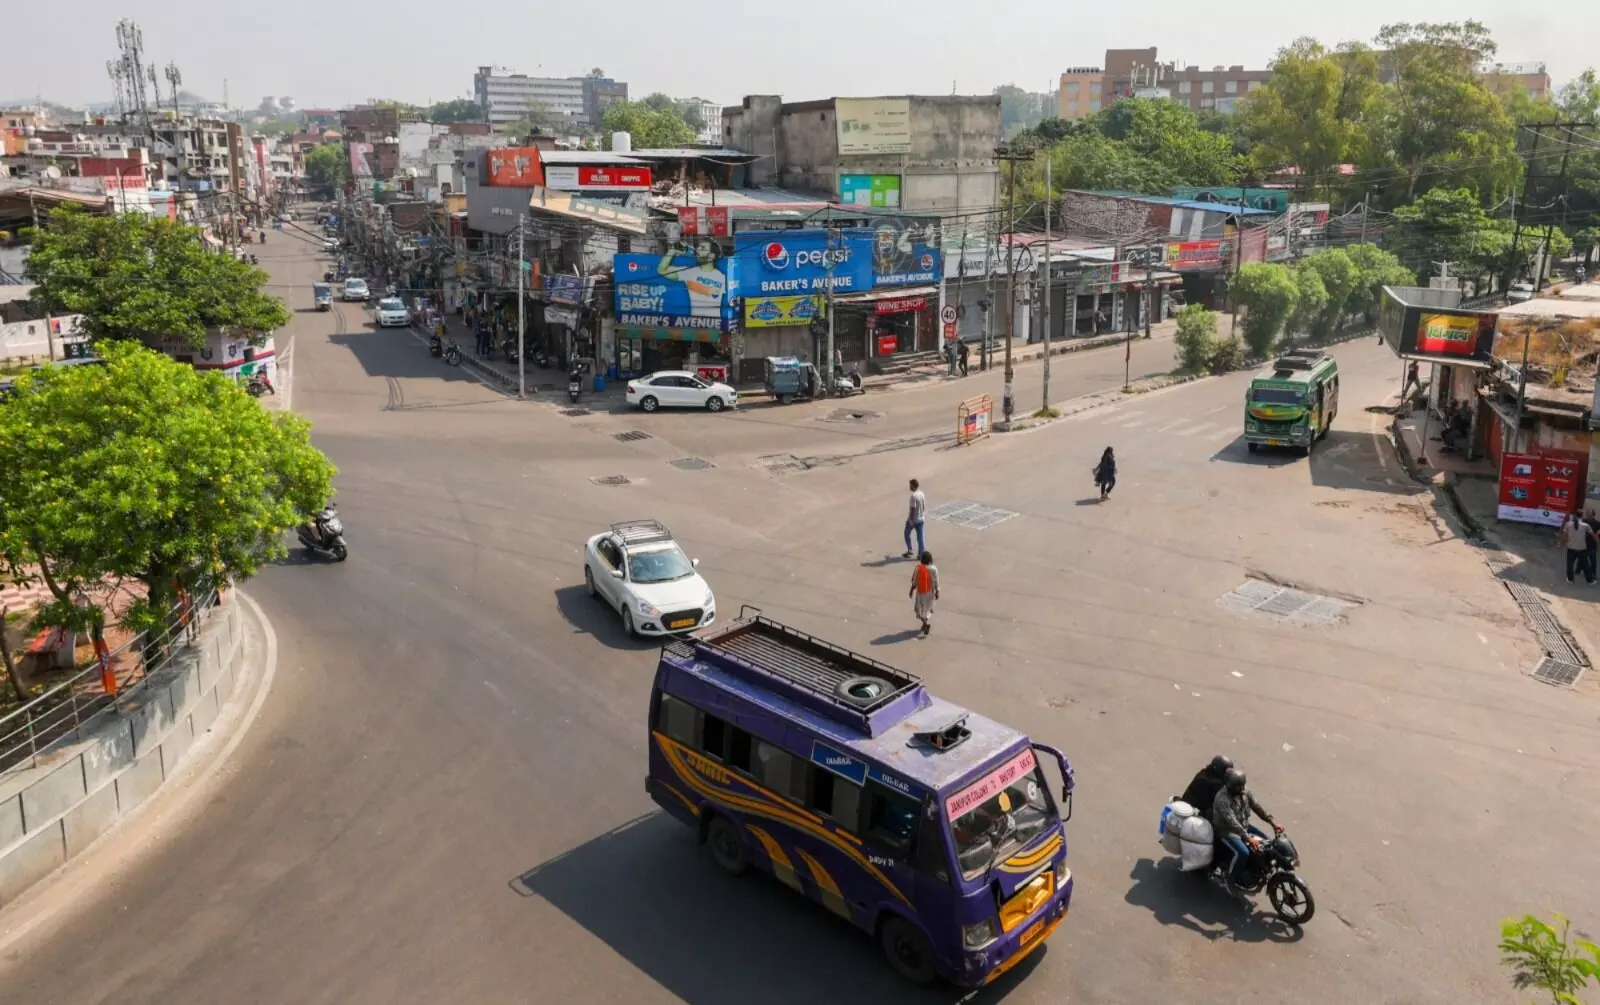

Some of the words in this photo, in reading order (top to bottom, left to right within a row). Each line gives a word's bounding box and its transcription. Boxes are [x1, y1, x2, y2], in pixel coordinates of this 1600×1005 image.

[796, 247, 852, 269] pepsi
[618, 283, 649, 297] RISE
[650, 285, 667, 297] UP
[762, 277, 808, 292] BAKER'S
[620, 297, 664, 312] BABY!
[878, 301, 900, 311] WINE
[900, 299, 924, 308] SHOP
[621, 314, 670, 326] BAKER'S
[674, 316, 721, 329] AVENUE
[943, 310, 954, 320] 40
[970, 785, 989, 802] COLONY
